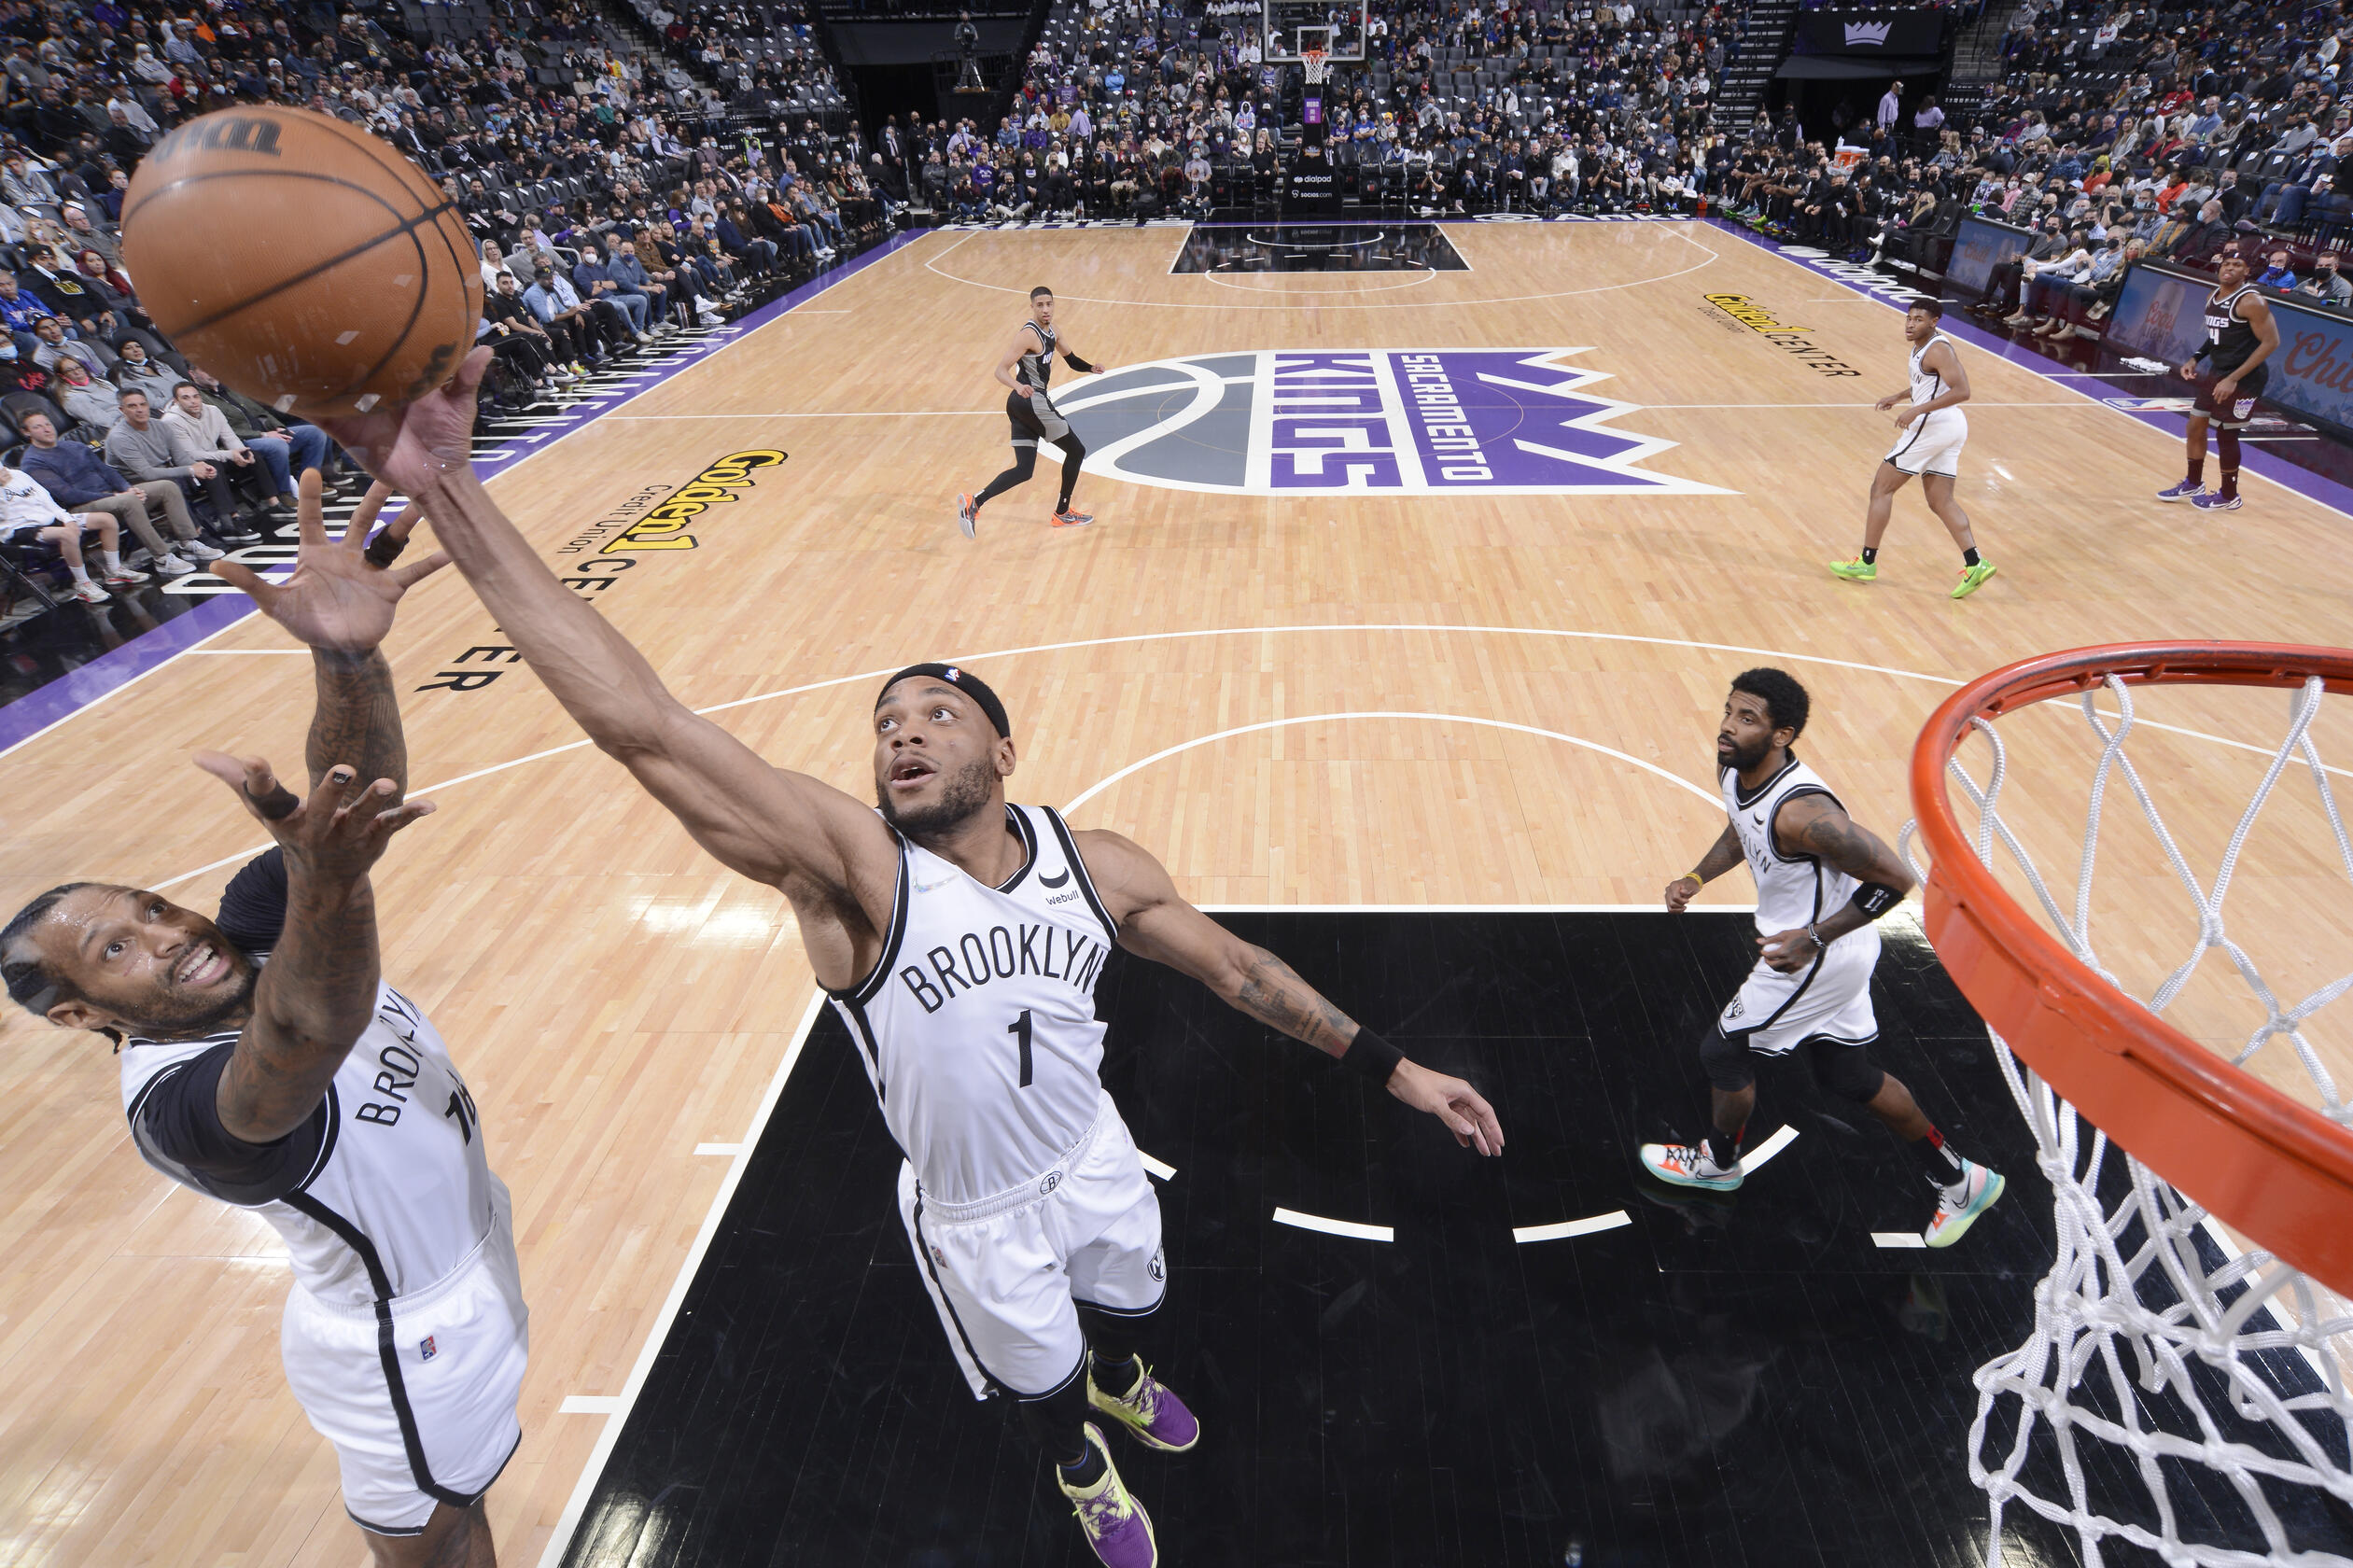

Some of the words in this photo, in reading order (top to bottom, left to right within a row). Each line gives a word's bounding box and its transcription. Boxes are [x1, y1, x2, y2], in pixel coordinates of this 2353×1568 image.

[1304, 175, 1332, 184] dialpad
[1808, 258, 1958, 303] dialpad
[2205, 315, 2230, 329] NGS
[1764, 333, 1862, 377] CENTER
[468, 327, 743, 462] SACRAMENTO
[1270, 353, 1404, 488] KINGS
[1400, 355, 1493, 480] SACRAMENTO
[609, 484, 673, 516] Credit
[557, 519, 628, 553] Union
[413, 558, 637, 693] CEER
[1045, 889, 1080, 906] Webull
[899, 924, 1104, 1015] BROOKLYN
[1008, 1009, 1033, 1088] 1
